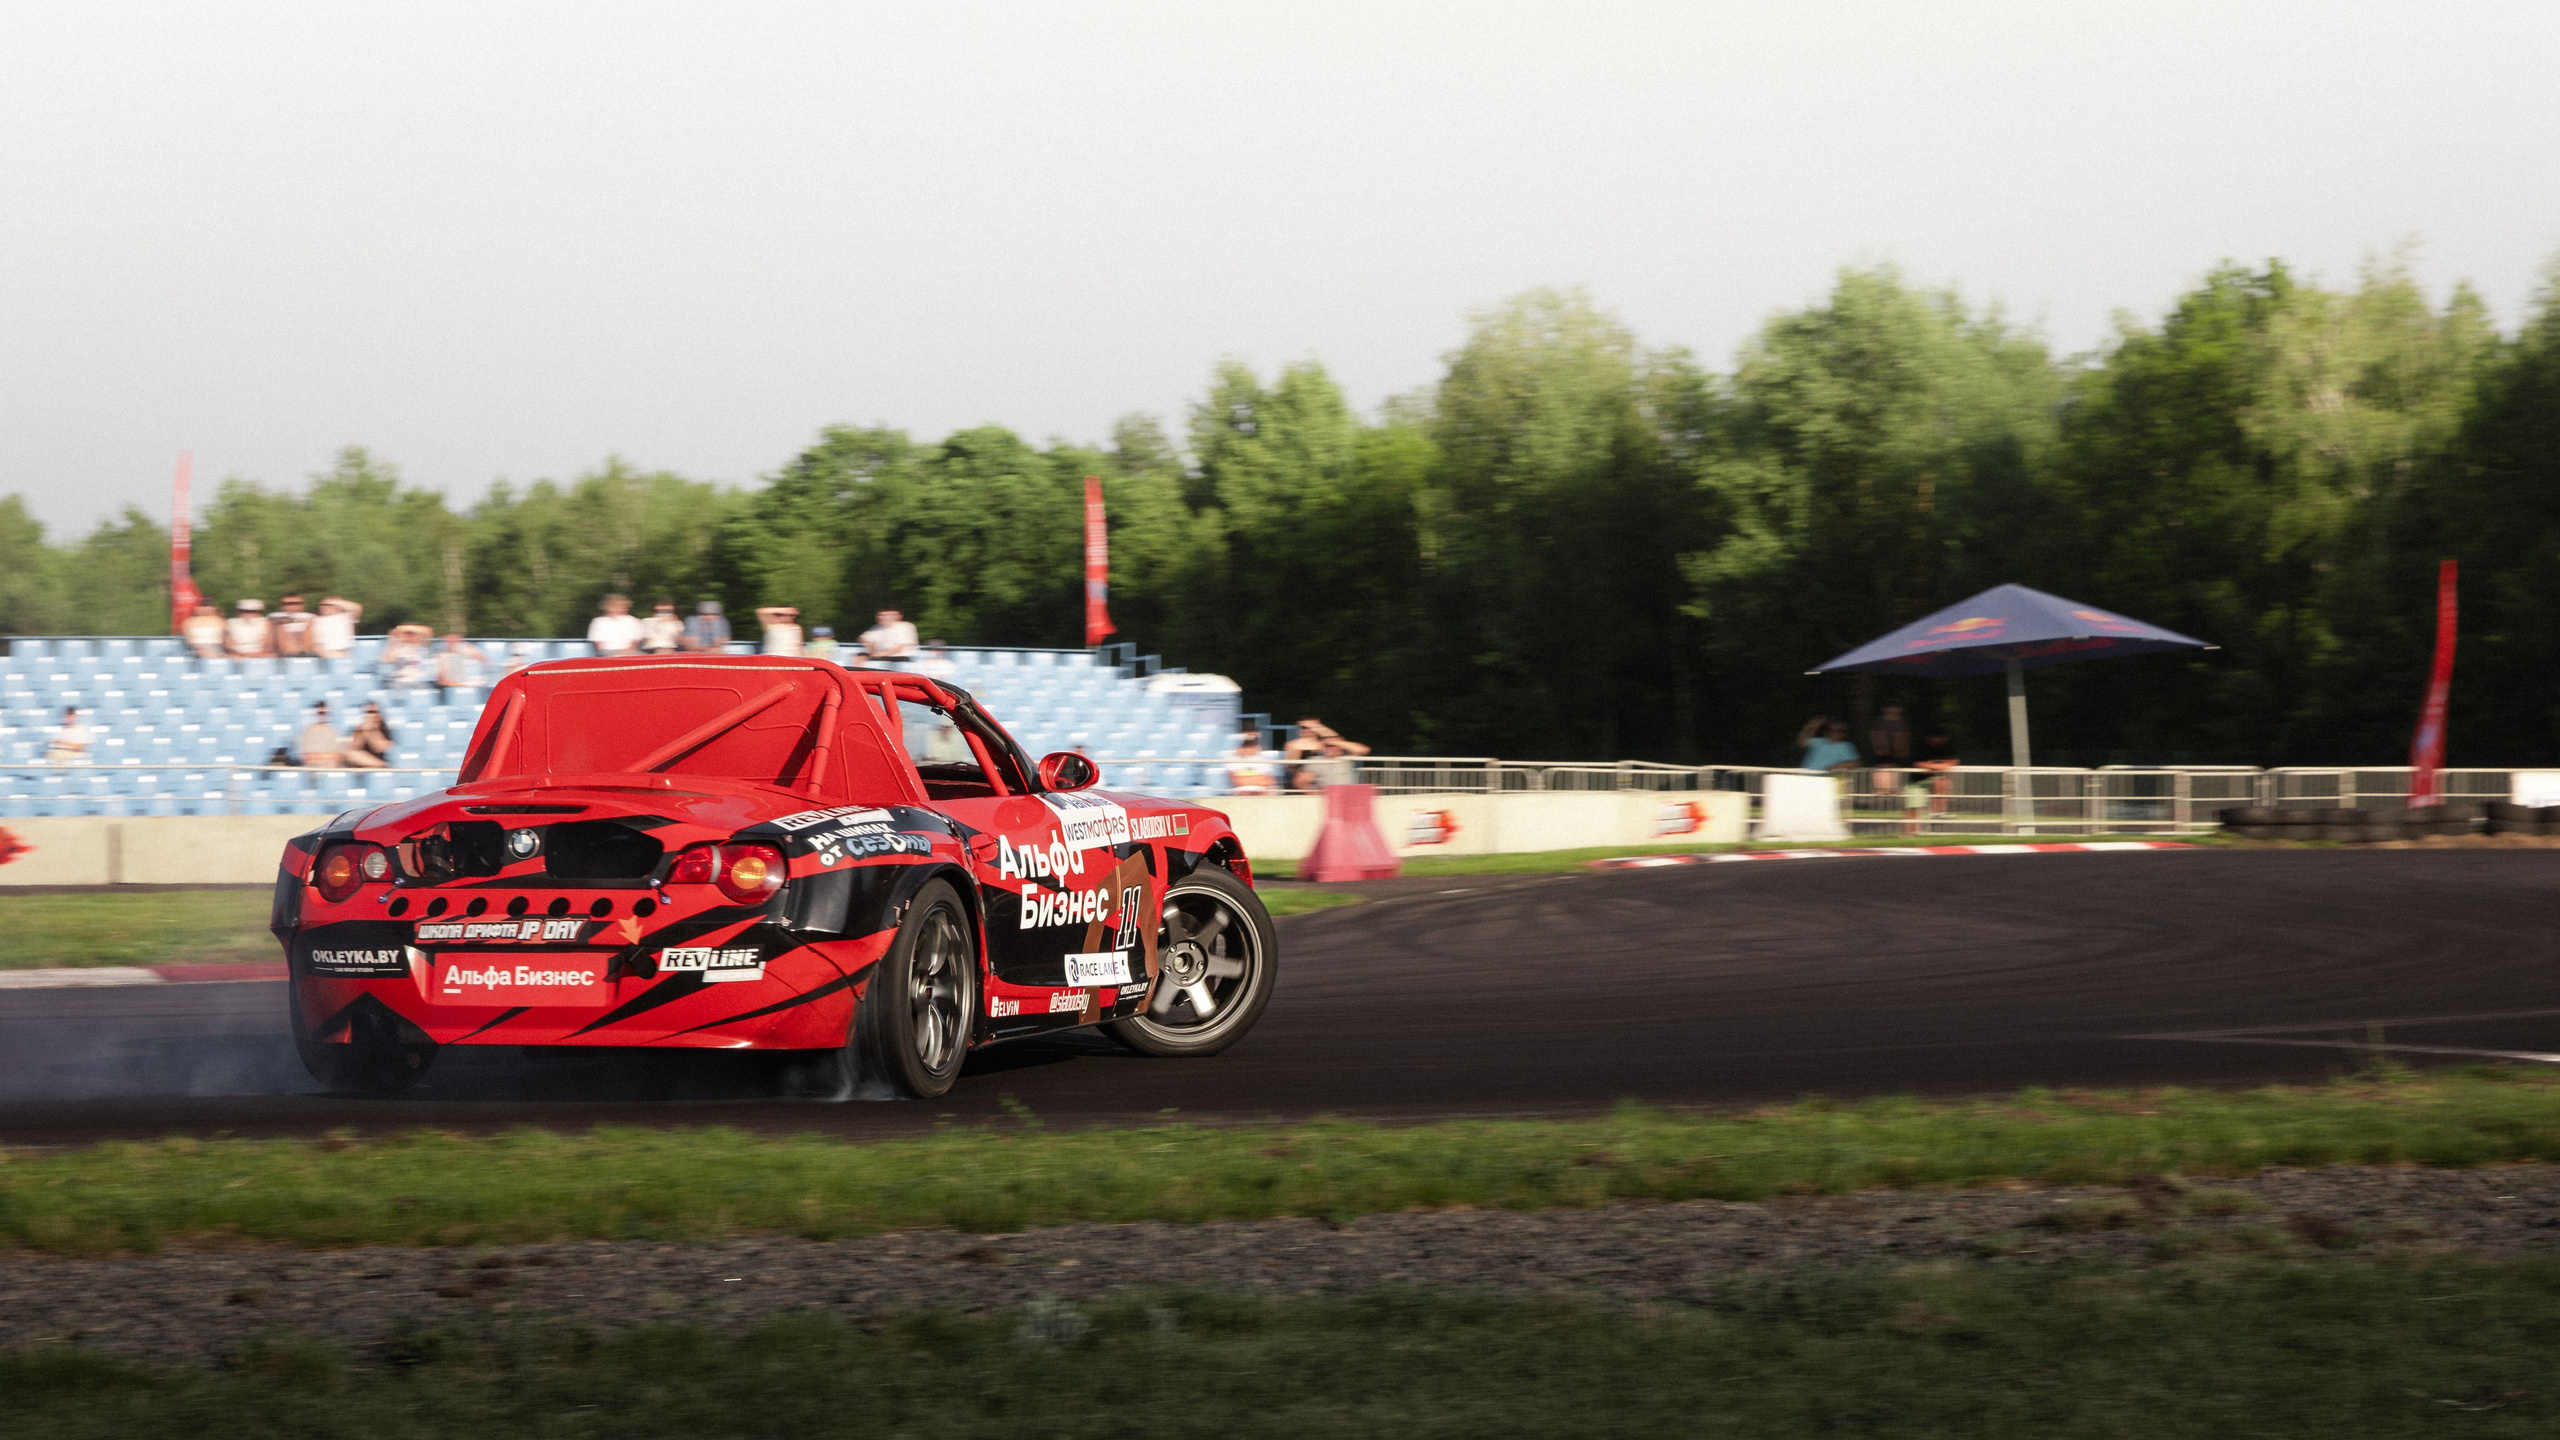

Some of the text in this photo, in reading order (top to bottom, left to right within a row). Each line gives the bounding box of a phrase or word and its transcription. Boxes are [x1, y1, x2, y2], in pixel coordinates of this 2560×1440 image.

[807, 823, 896, 850] НА ШИНАХ
[1064, 815, 1126, 841] WESTMOTORS
[999, 829, 1084, 887] Альфа
[1020, 883, 1109, 929] Бизнес
[1115, 885, 1142, 950] 11
[517, 920, 541, 940] JP
[542, 920, 583, 940] DAY
[312, 949, 399, 963] OKLEYKA.BY
[1080, 962, 1098, 976] RACE
[1098, 962, 1119, 976] LANE
[444, 965, 595, 990] Альфа Бизнес
